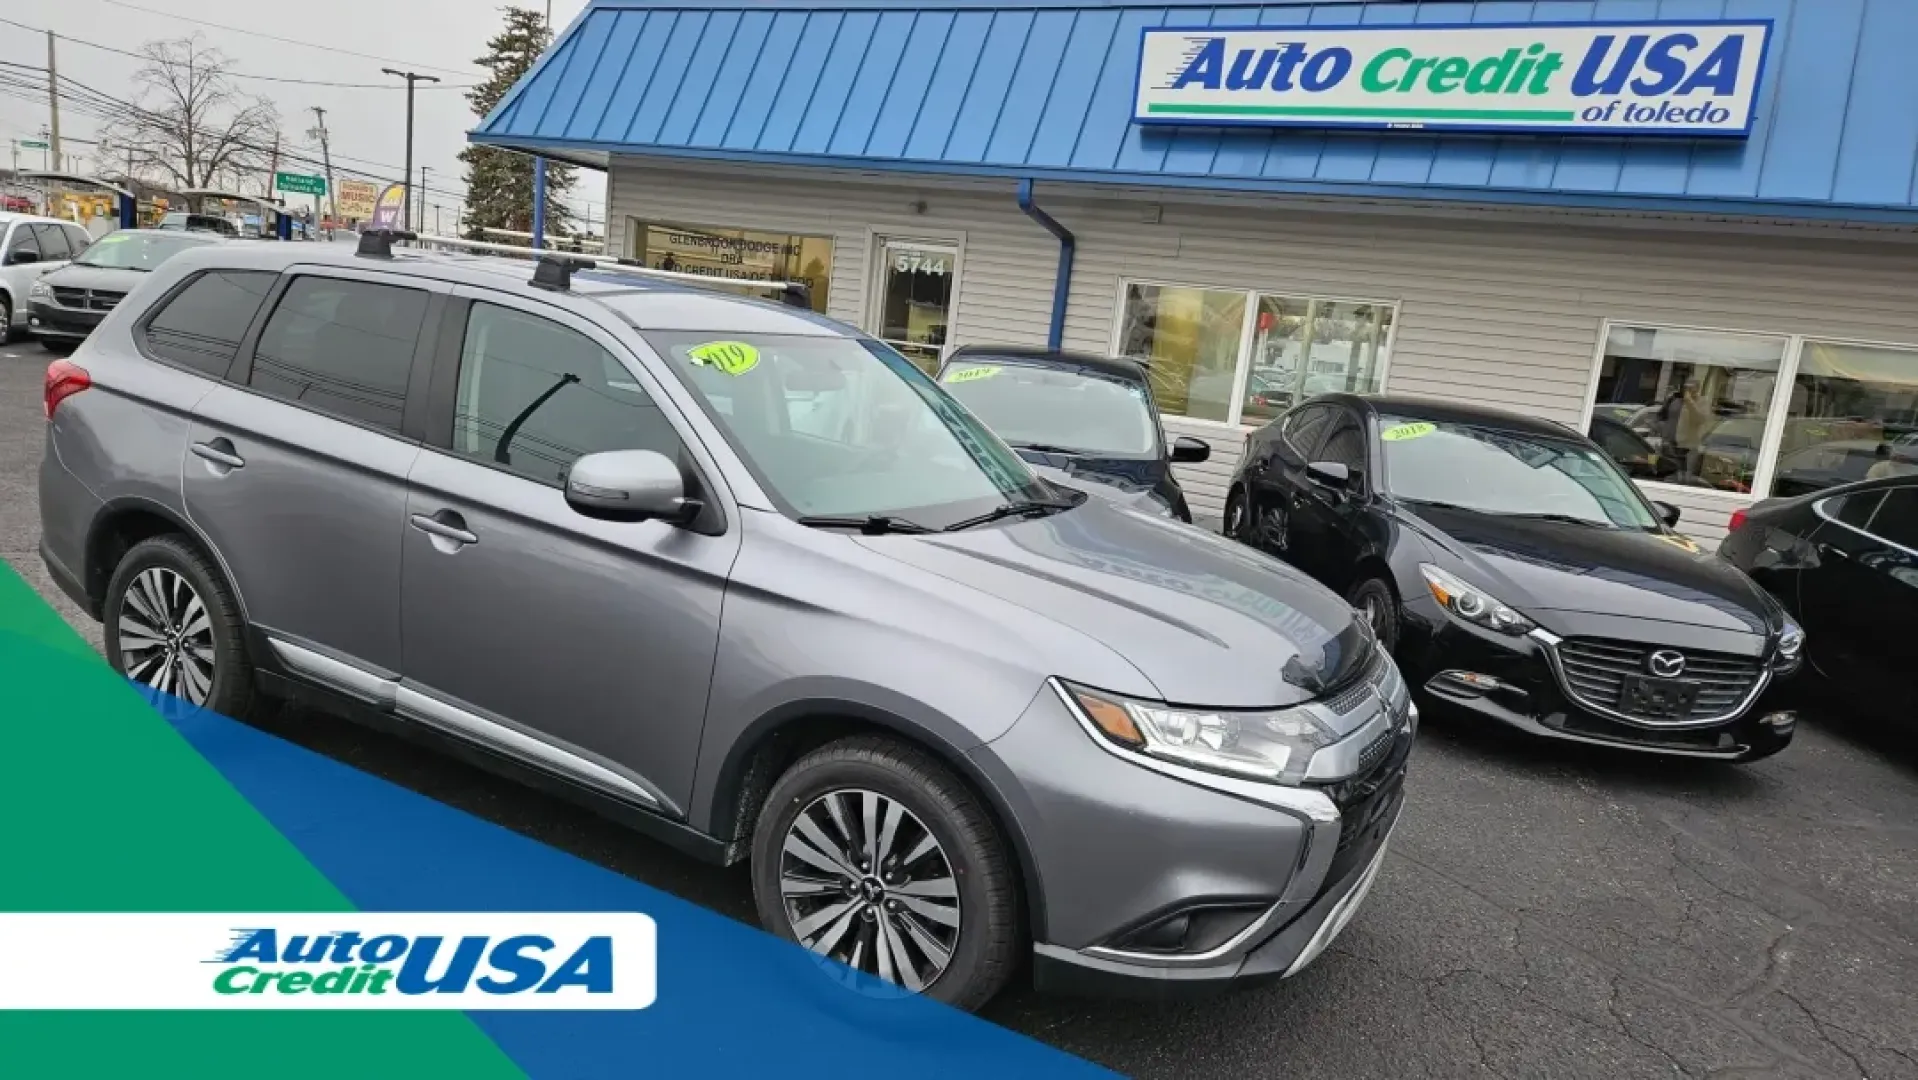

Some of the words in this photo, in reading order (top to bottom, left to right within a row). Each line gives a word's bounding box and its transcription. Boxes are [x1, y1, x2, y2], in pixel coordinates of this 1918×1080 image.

[1166, 37, 1353, 92] Auto
[1360, 42, 1564, 95] Credit
[1571, 33, 1745, 97] USA
[1582, 101, 1621, 123] of
[1623, 101, 1731, 123] toledo
[897, 255, 944, 276] 5744
